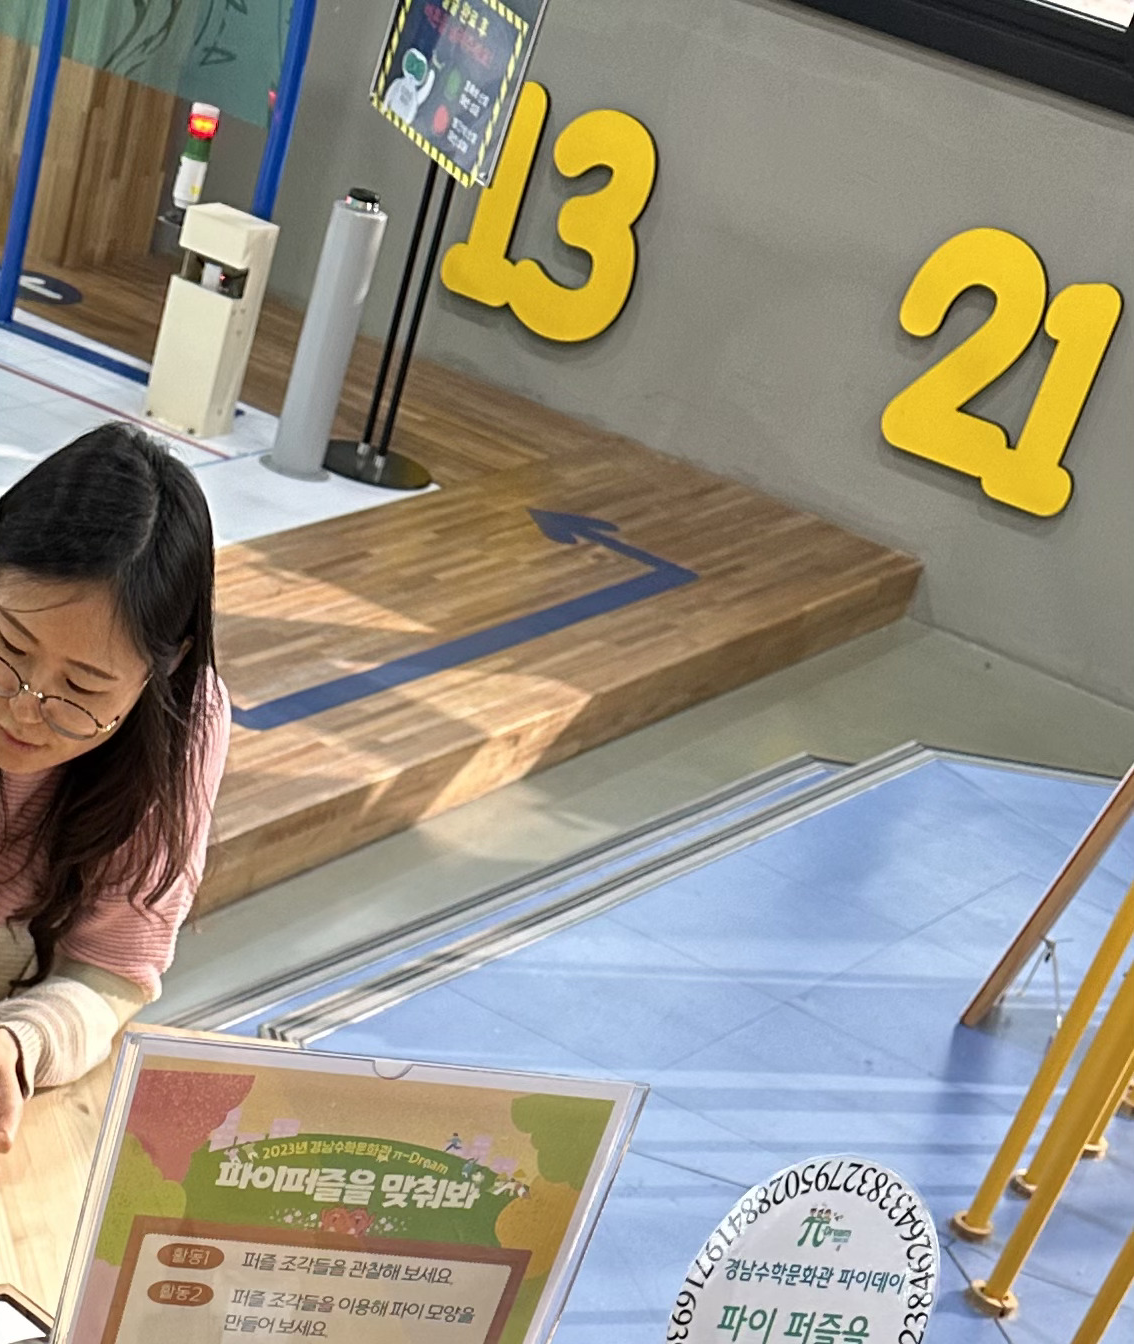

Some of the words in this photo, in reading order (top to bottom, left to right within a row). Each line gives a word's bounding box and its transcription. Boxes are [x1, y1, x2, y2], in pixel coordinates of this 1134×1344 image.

[441, 81, 658, 342] 13
[881, 227, 1122, 517] 21
[215, 1161, 376, 1206] 파이퍼즐을
[380, 1173, 481, 1209] 맞춰봐
[242, 1252, 277, 1272] 퍼즐
[279, 1255, 346, 1277] 조각들을
[349, 1260, 400, 1281] 관찰해
[724, 1258, 834, 1289] 경남수학문화관
[837, 1268, 907, 1295] 파이데이
[224, 1314, 274, 1335] 만들어
[232, 1289, 266, 1308] 퍼즐
[269, 1292, 334, 1314] 조각들을
[338, 1297, 388, 1318] 이용해
[390, 1300, 424, 1320] 파이
[425, 1304, 476, 1325] 모양을
